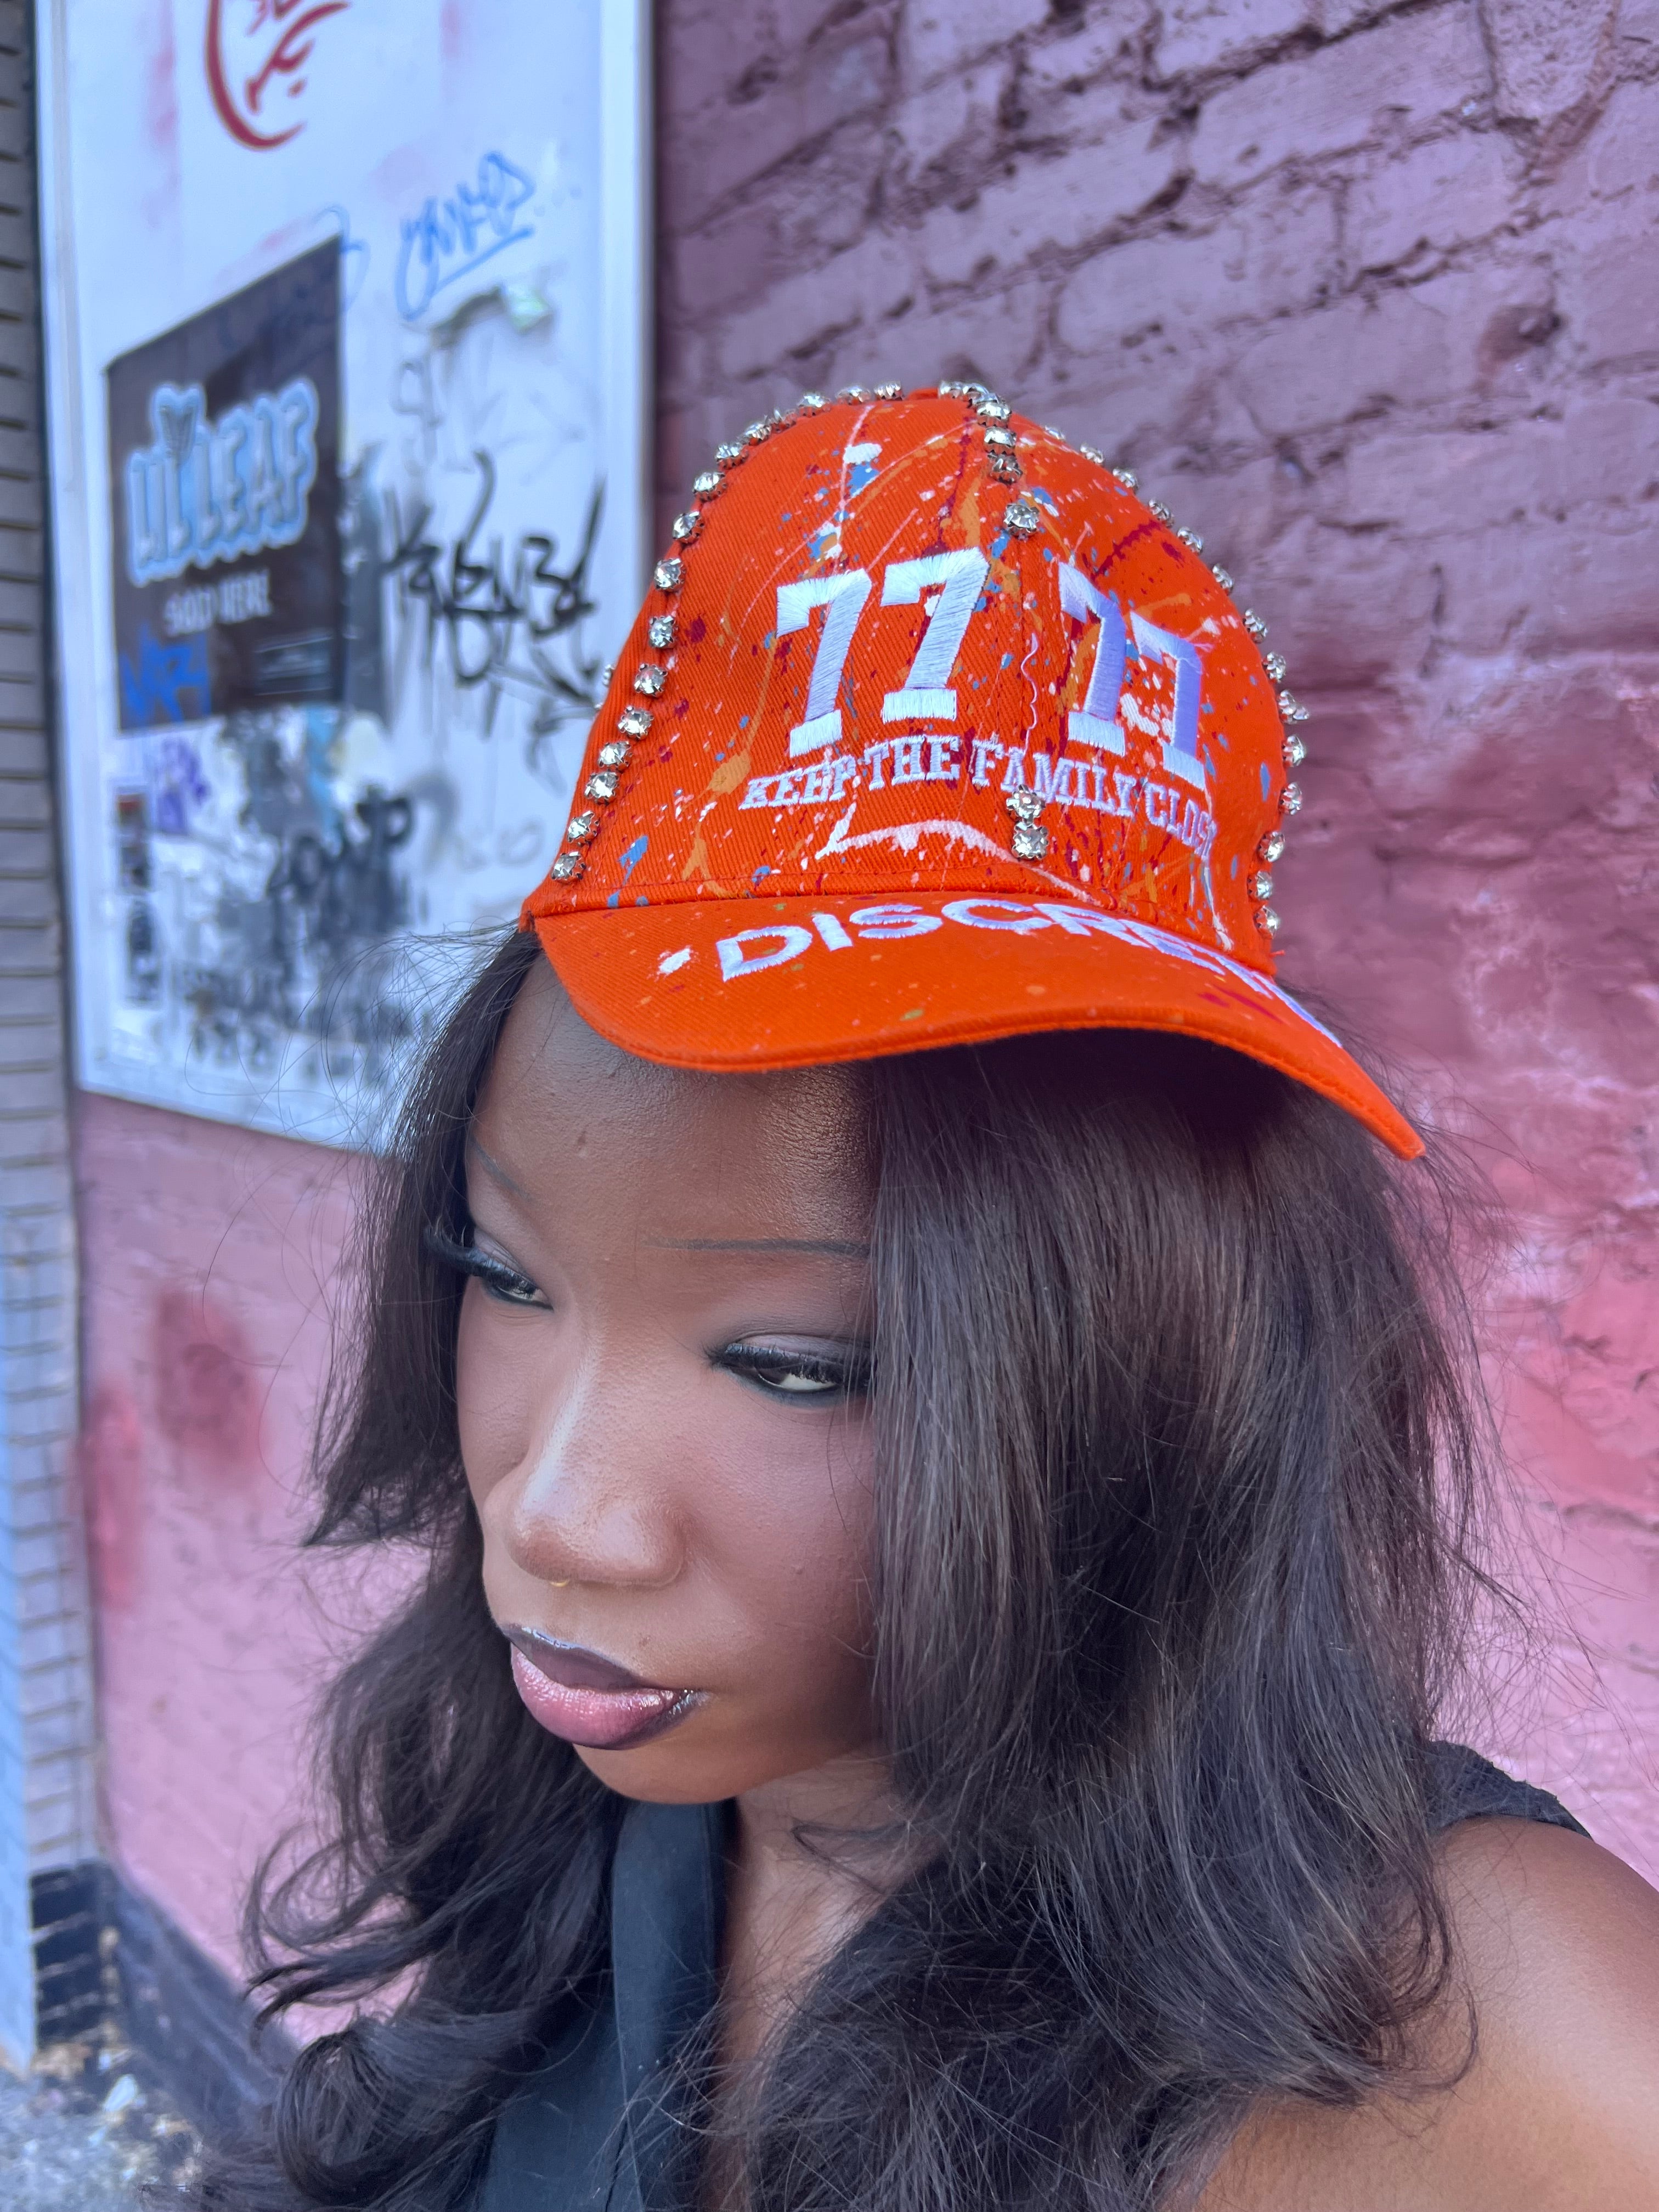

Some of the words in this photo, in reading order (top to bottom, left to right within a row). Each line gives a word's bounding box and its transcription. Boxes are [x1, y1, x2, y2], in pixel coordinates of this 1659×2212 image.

[738, 754, 856, 810] KEEP
[864, 734, 960, 790] THE
[971, 738, 1137, 817] FAMILY
[716, 898, 1342, 1048] DISCRET
